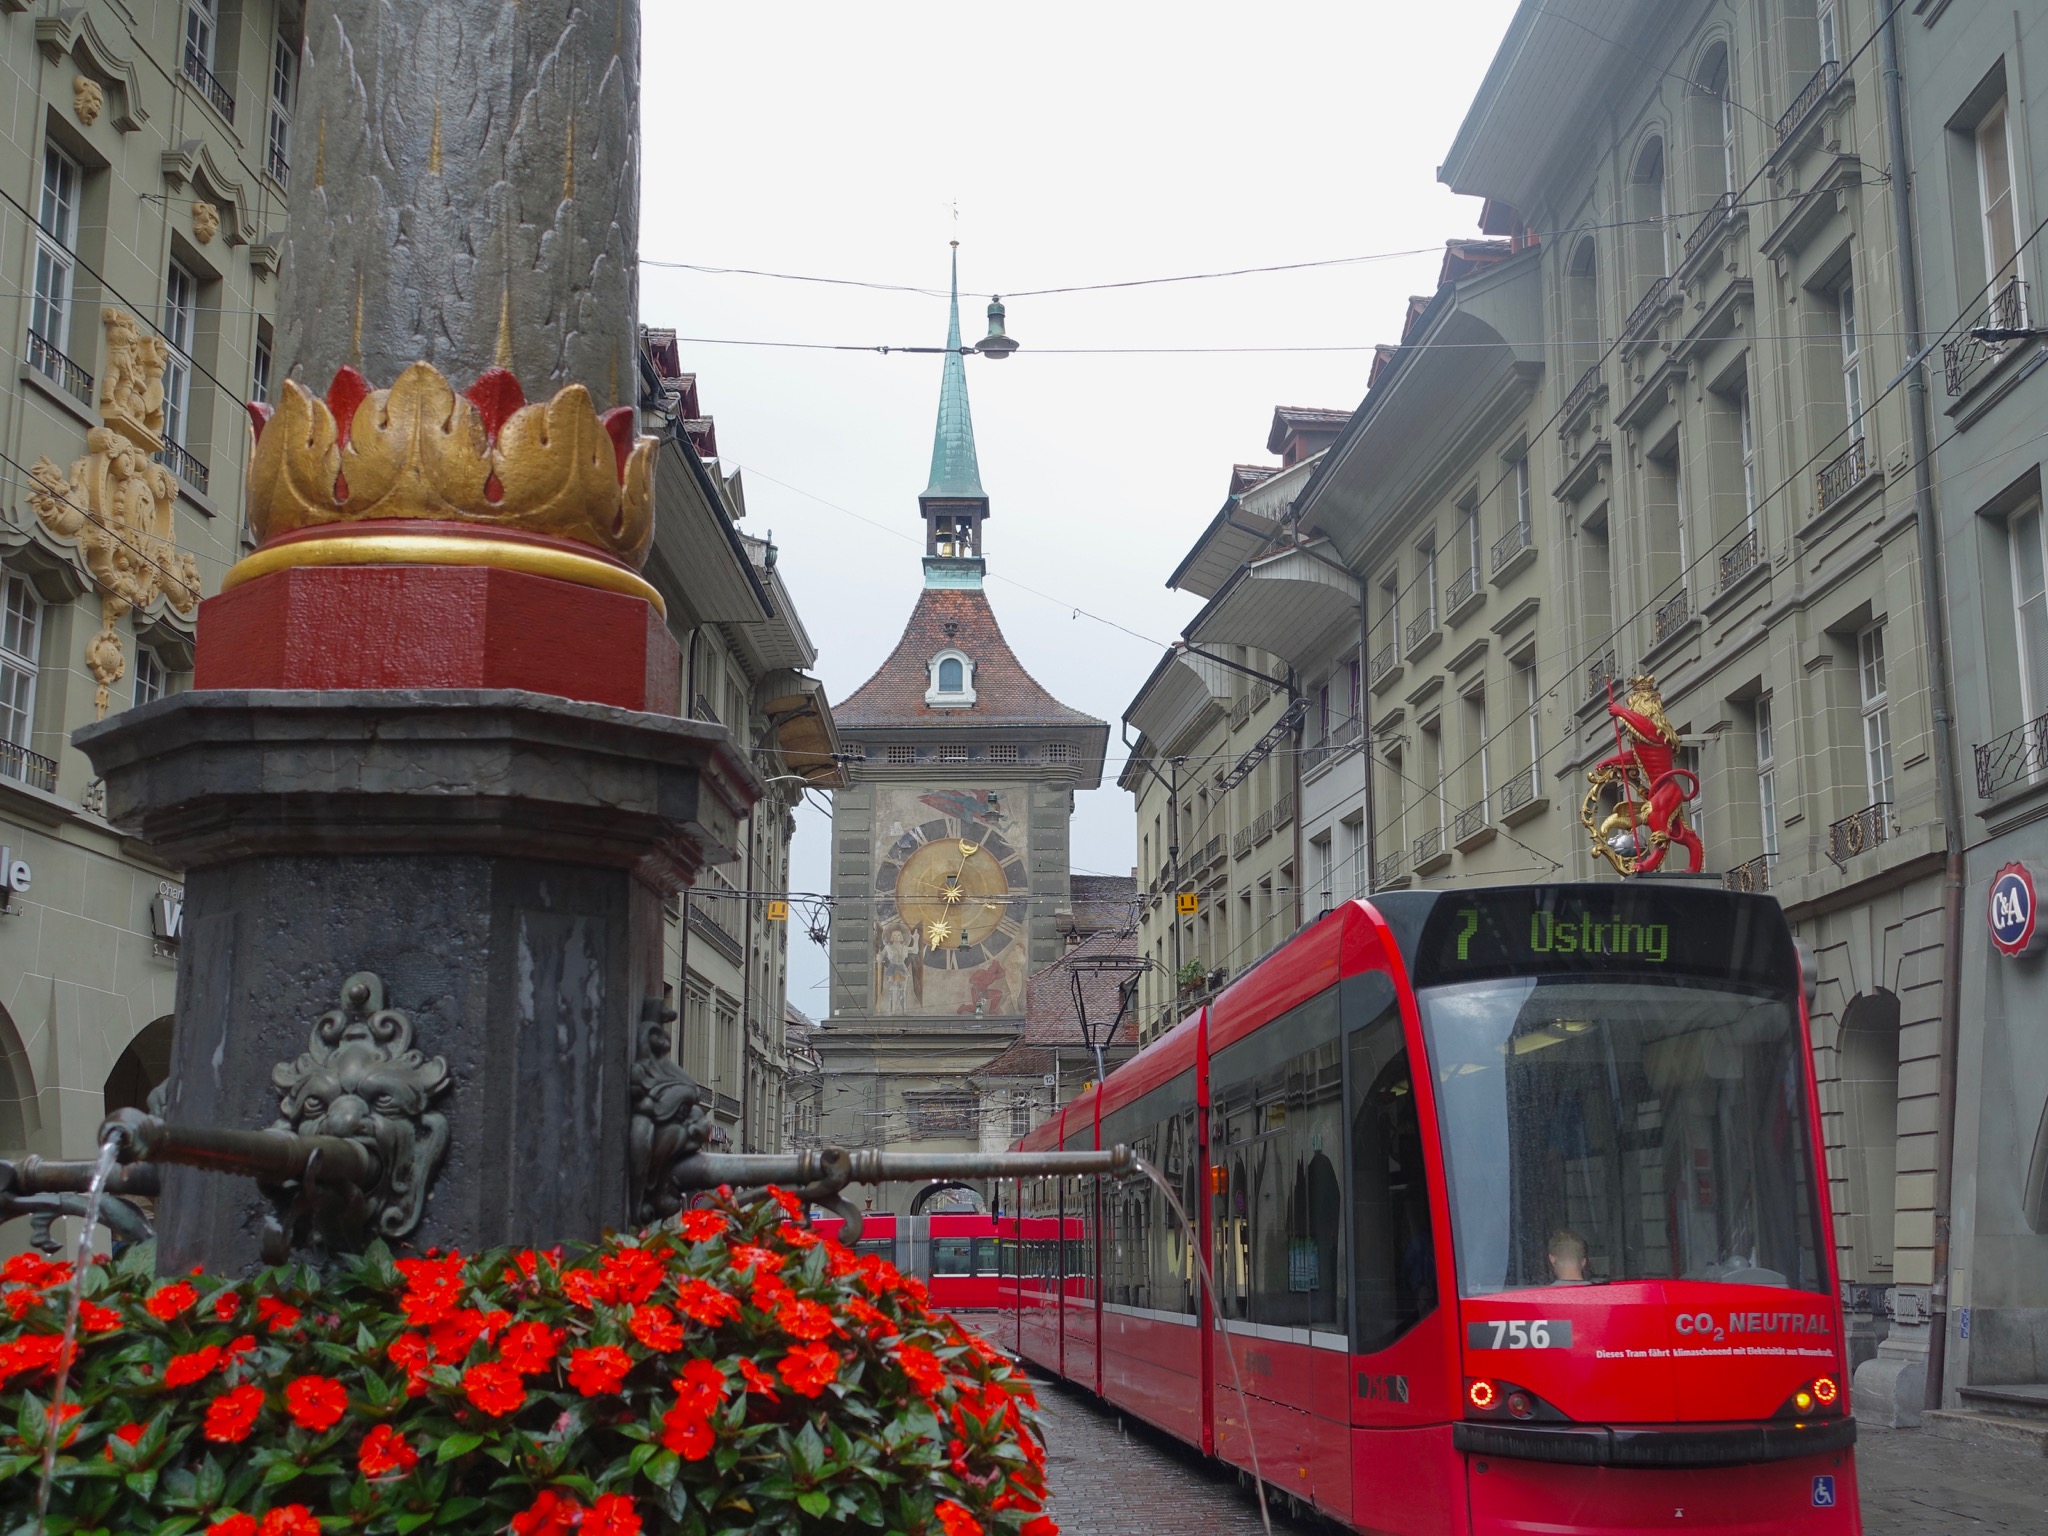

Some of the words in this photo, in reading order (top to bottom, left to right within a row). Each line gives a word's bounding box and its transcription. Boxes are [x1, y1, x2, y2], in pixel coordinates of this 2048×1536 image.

[1992, 887, 2025, 931] C&A
[1457, 909, 1478, 961] 7
[1530, 910, 1668, 962] Ostring
[1045, 1076, 1053, 1084] 12
[1488, 1320, 1550, 1350] 756
[1729, 1312, 1831, 1335] NEUTRAL
[1596, 1349, 1625, 1359] Dieses
[1625, 1349, 1648, 1358] Tram
[1648, 1348, 1671, 1357] fährt
[1673, 1346, 1732, 1357] klimaschonend
[1733, 1346, 1746, 1356] mit
